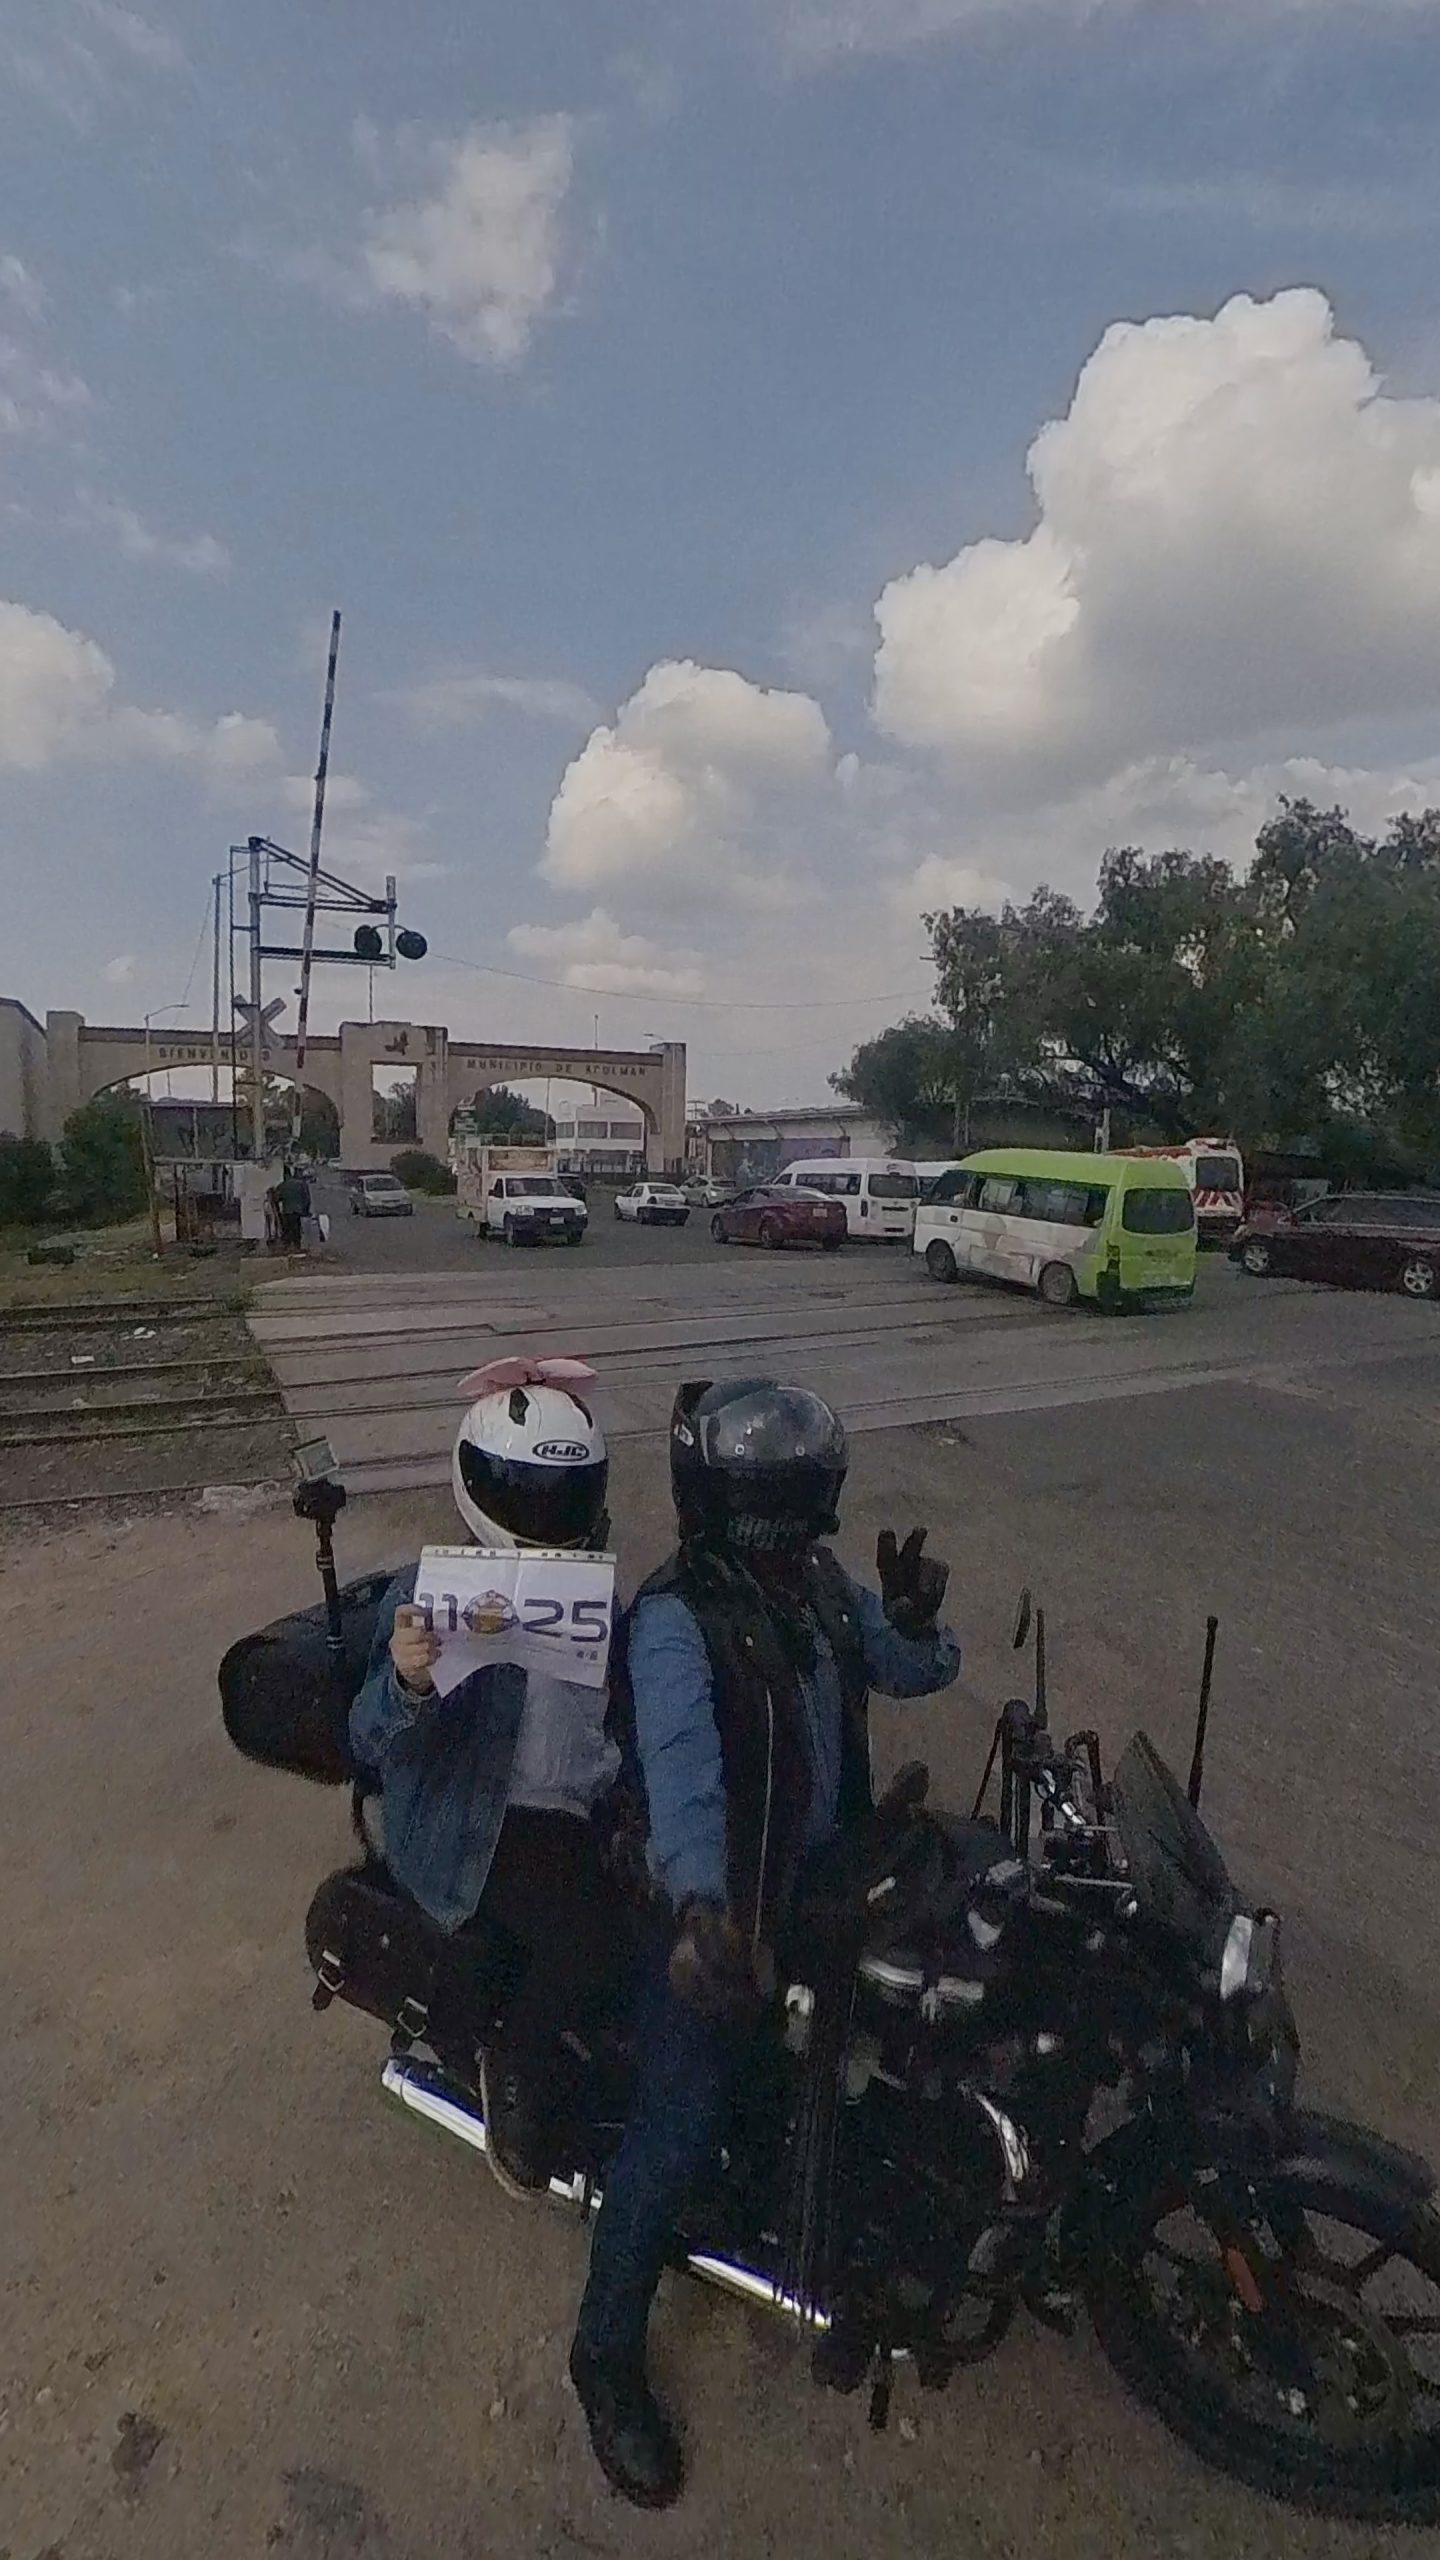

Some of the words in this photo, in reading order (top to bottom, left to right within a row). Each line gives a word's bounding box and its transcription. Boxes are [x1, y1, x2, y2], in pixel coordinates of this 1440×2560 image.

[467, 1059, 542, 1073] MUNICIPIO
[556, 1063, 573, 1073] DE
[541, 1445, 583, 1456] HJC
[522, 1599, 608, 1643] 25
